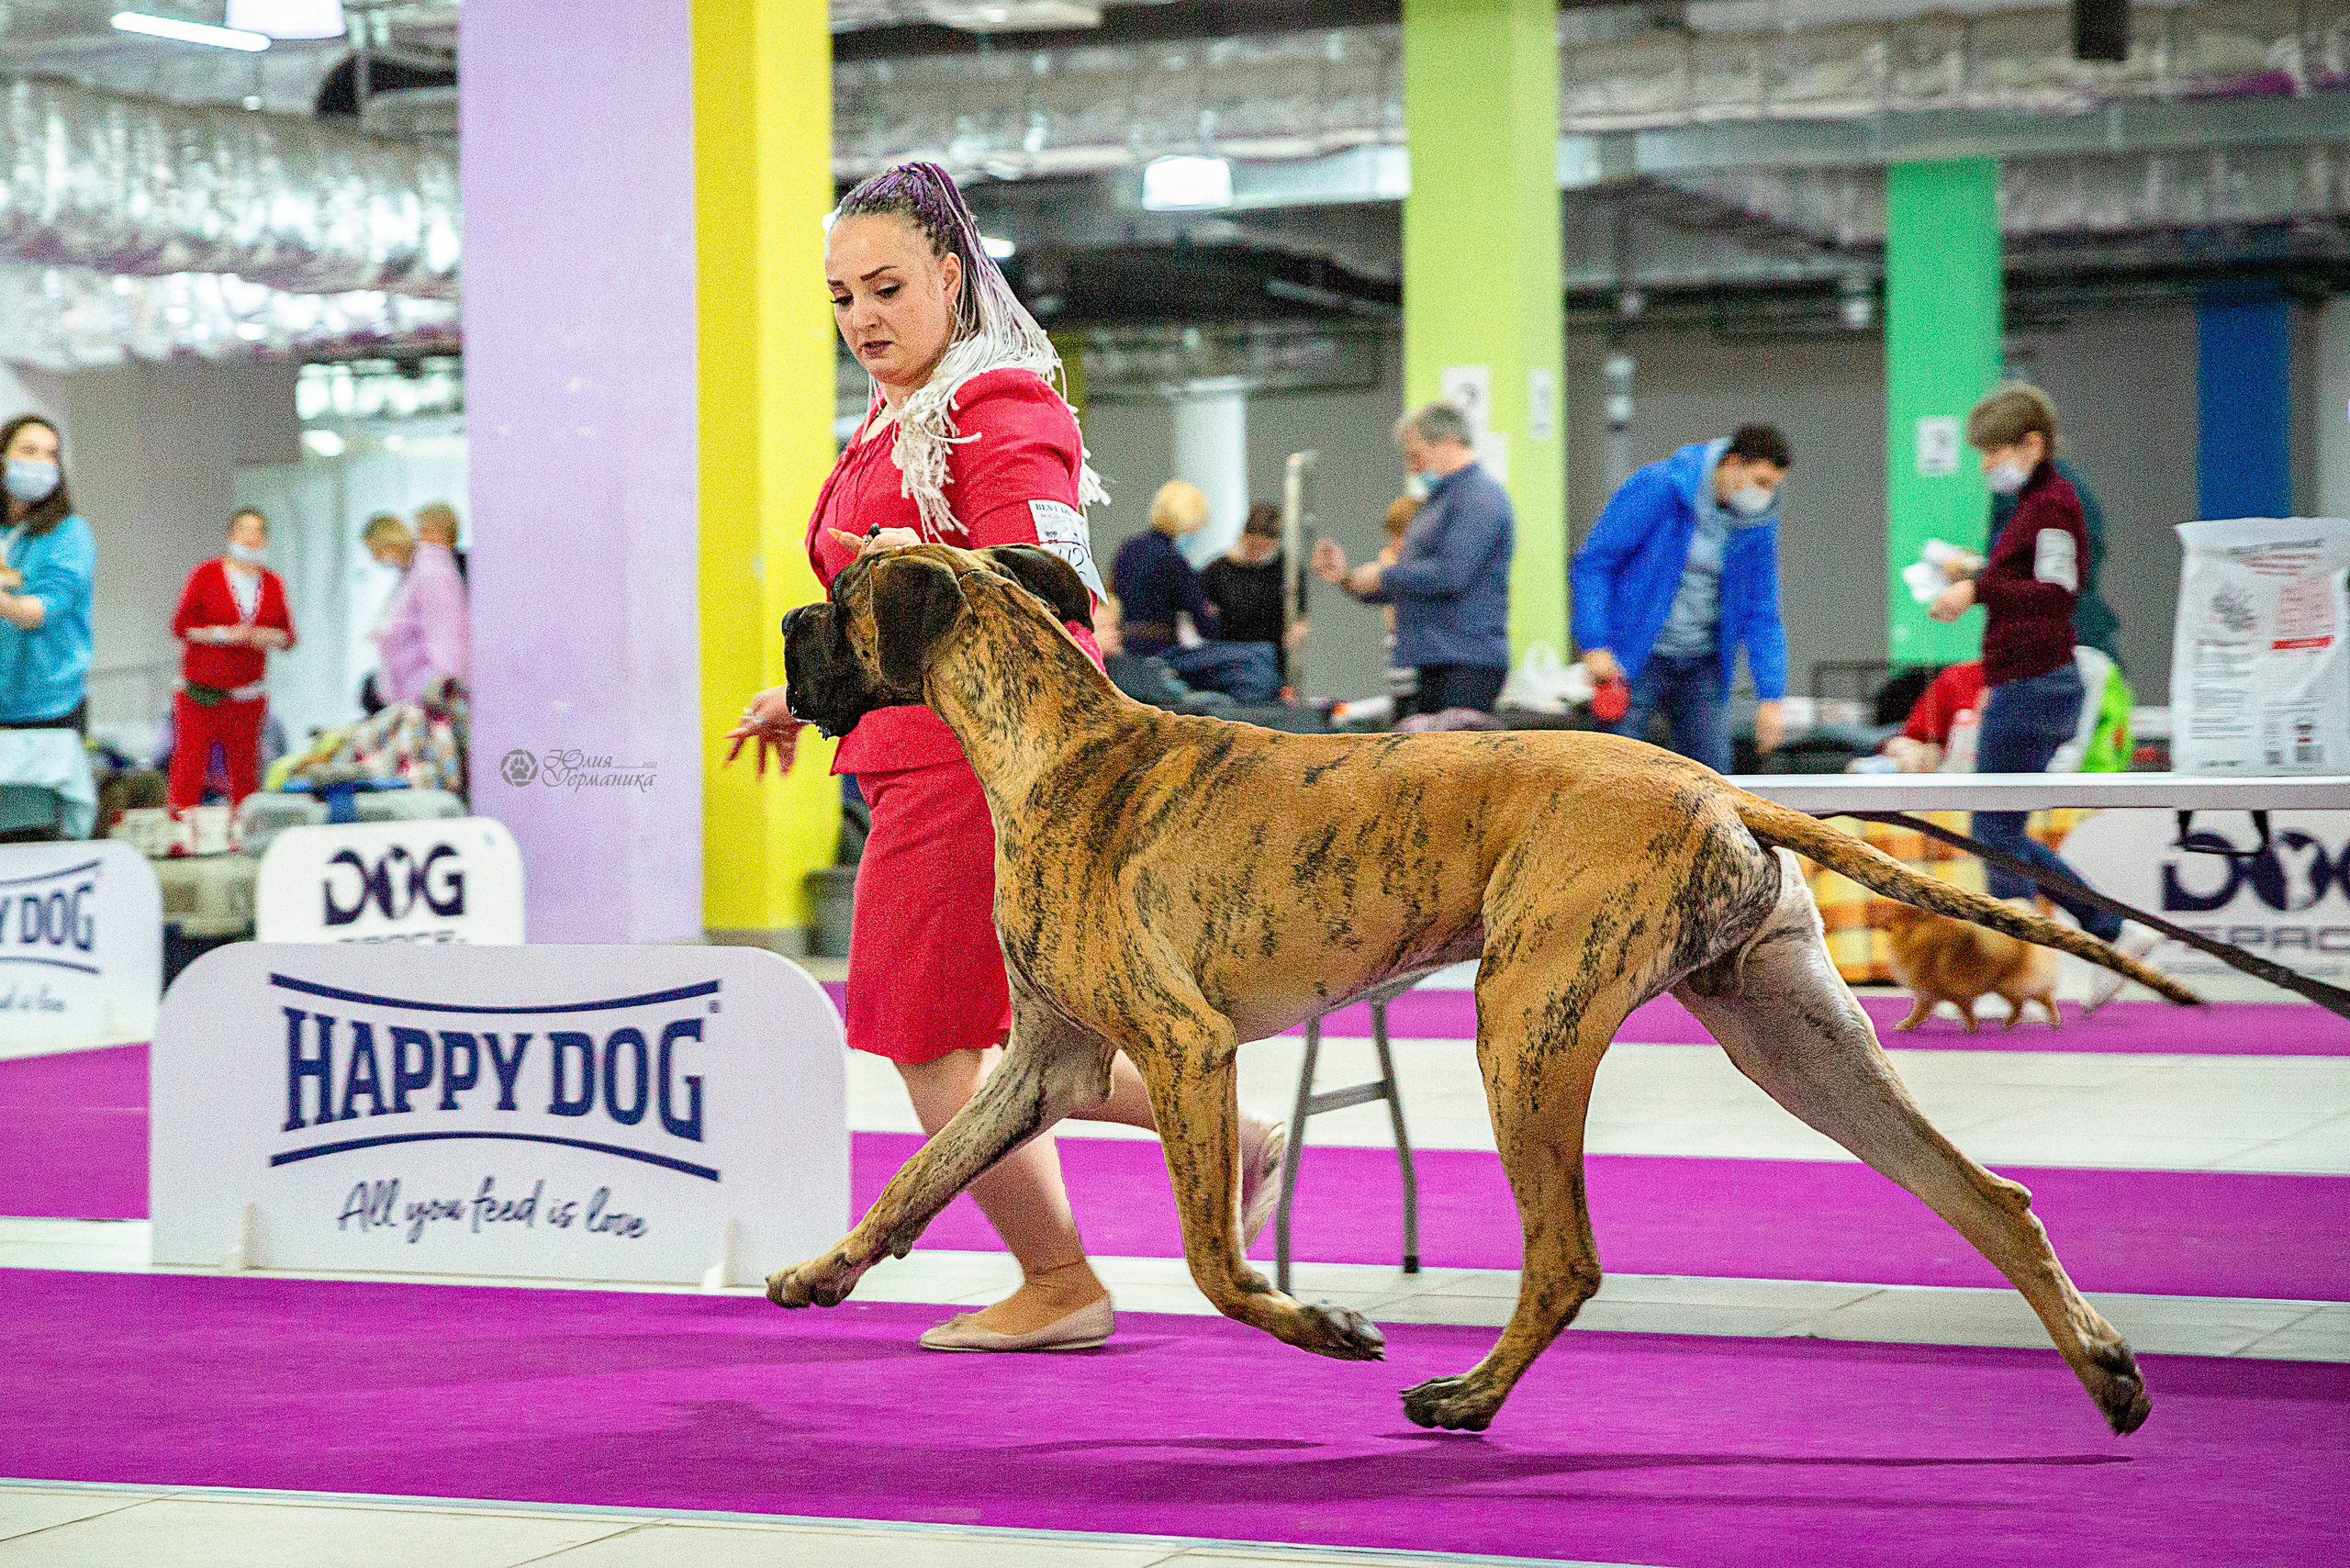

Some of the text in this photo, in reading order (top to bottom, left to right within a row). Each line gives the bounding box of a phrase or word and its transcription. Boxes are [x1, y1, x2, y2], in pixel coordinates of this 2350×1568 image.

[323, 842, 467, 926] DOG
[2162, 828, 2350, 912] DO
[20, 879, 95, 953] DOG
[281, 1005, 705, 1143] HAPPY DOG
[337, 1175, 648, 1245] All you feed is love
